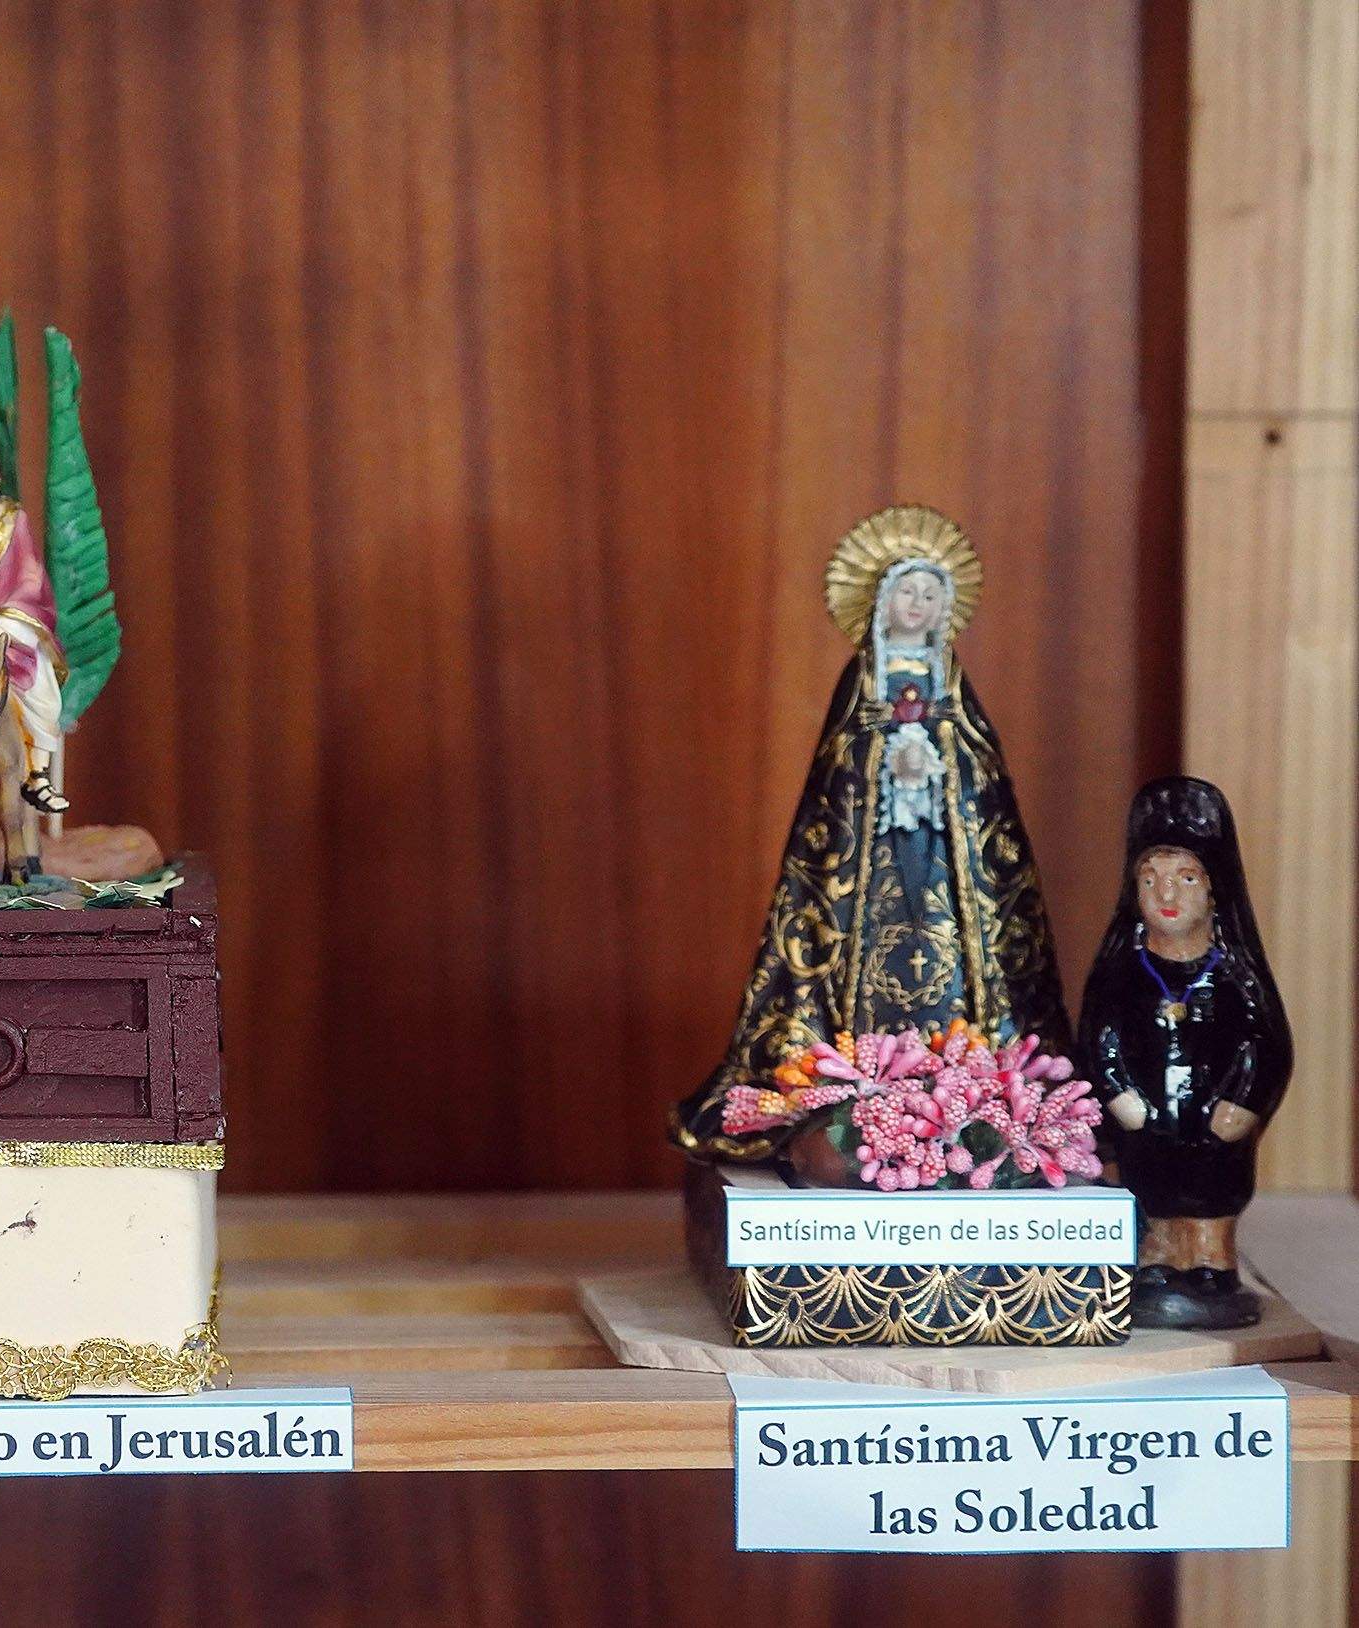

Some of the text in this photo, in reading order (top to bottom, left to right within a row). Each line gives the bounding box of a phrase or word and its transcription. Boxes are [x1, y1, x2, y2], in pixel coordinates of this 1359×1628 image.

[740, 1217, 1122, 1246] Santísima Virgen de las Soledad
[32, 1429, 92, 1460] en
[100, 1413, 343, 1472] Jerusalén
[758, 1412, 1273, 1474] Santísima Virgen de
[869, 1485, 1158, 1534] las Soledad
